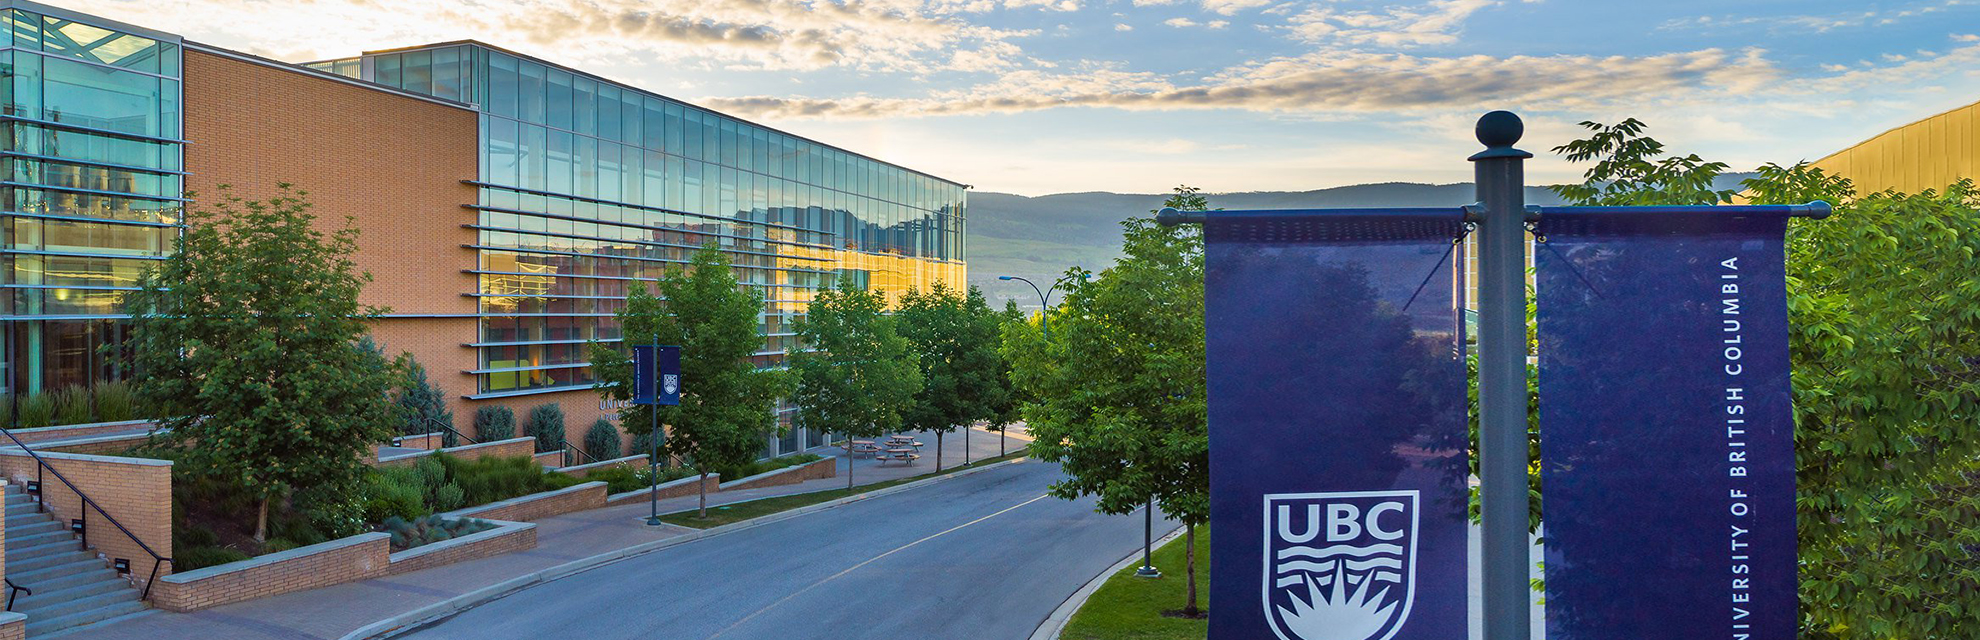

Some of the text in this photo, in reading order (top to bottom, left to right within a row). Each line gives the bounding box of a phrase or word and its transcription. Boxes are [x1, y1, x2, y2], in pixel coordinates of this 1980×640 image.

[1720, 256, 1743, 376] COLUMBIA
[1726, 388, 1747, 478] BRITISH
[1278, 501, 1405, 543] UBC
[1730, 489, 1748, 516] OF
